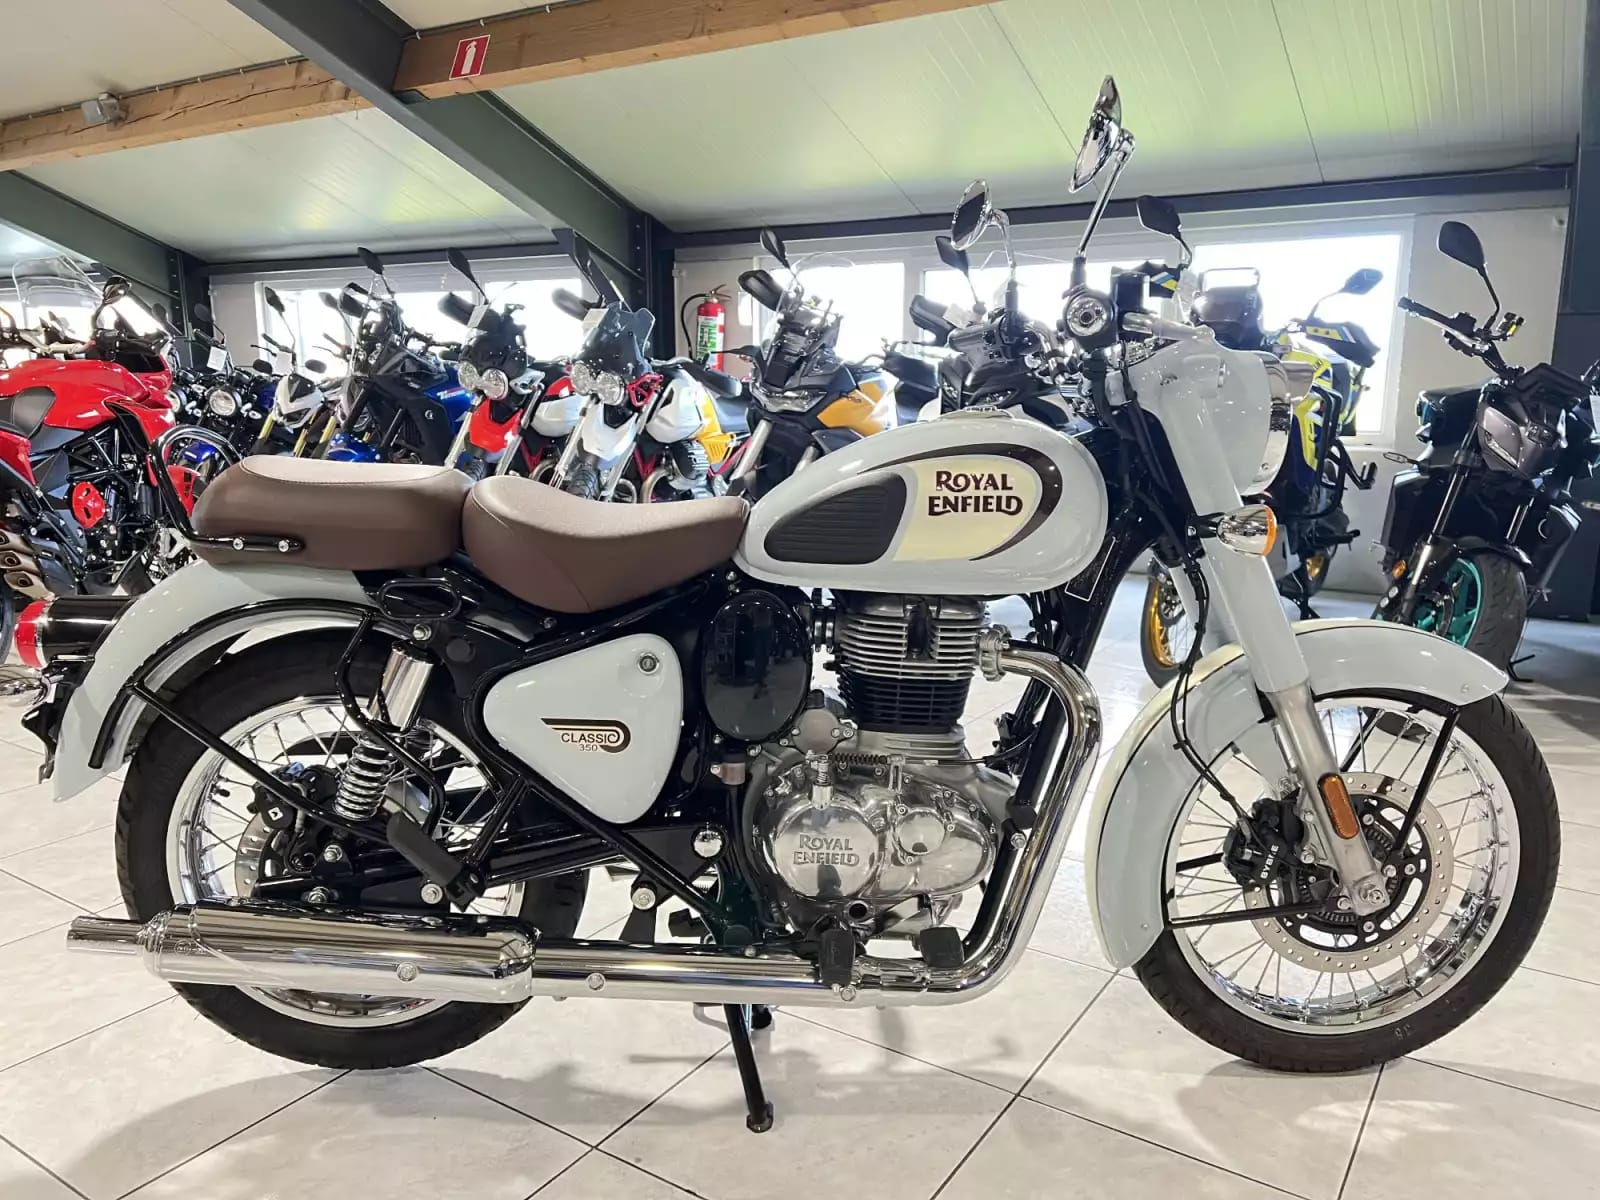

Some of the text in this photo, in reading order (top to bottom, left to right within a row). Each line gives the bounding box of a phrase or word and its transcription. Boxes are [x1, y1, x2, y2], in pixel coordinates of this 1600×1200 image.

[936, 470, 1013, 493] ROYAL
[928, 495, 1023, 516] ENFIELD
[561, 732, 619, 744] CLASSIC
[579, 744, 598, 752] 350
[799, 832, 853, 851] ROYAL
[793, 851, 860, 867] ENFIELD
